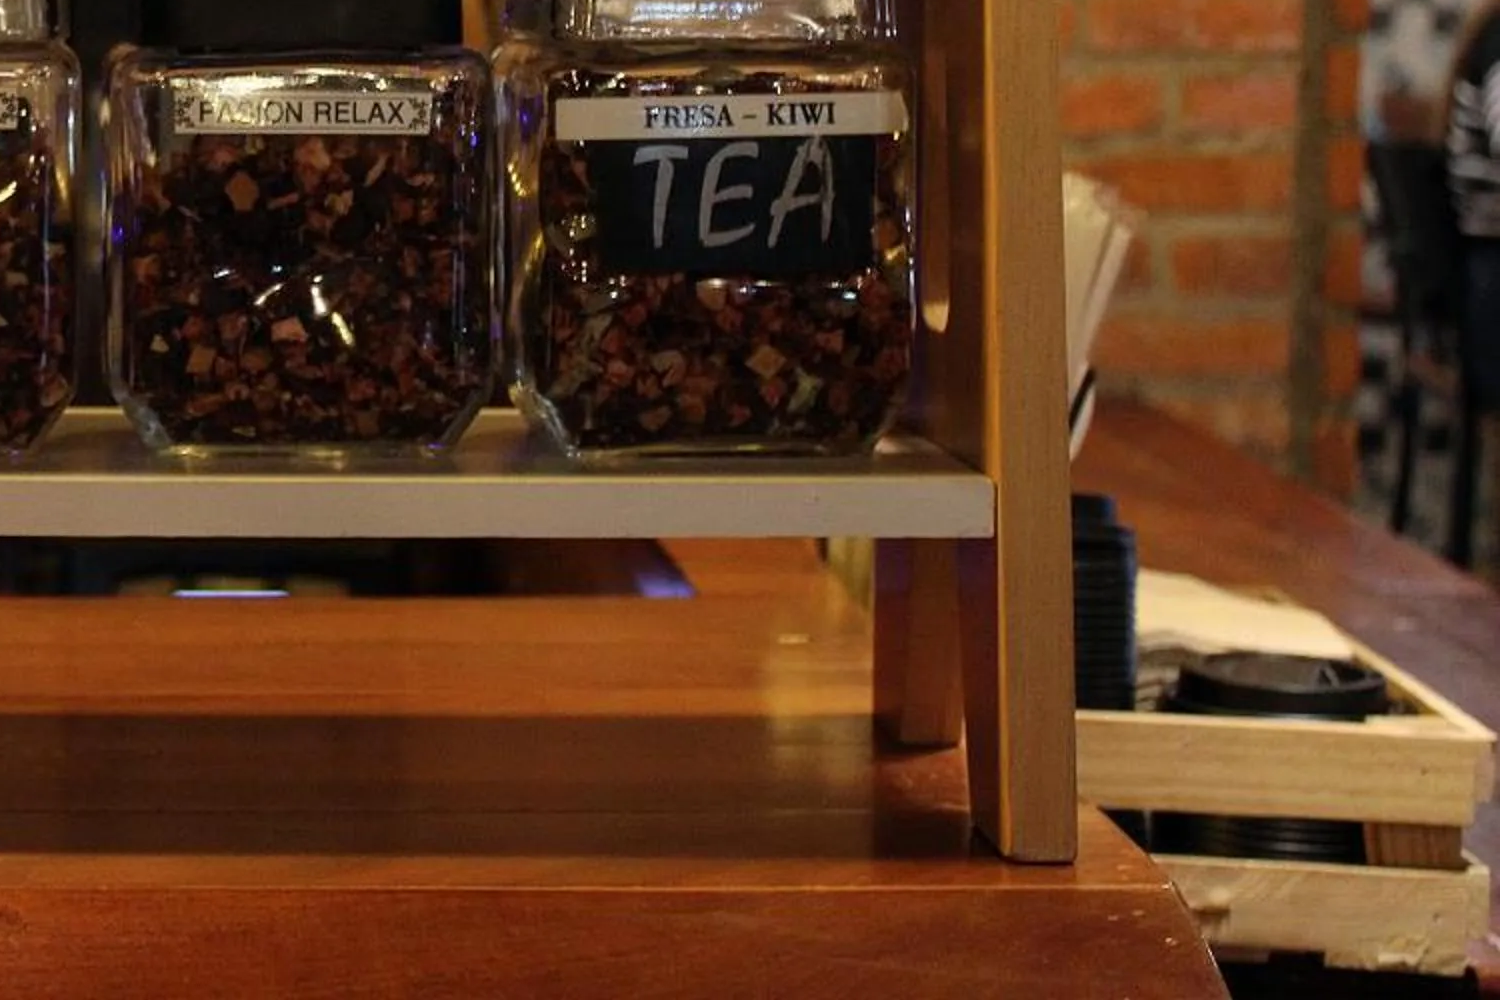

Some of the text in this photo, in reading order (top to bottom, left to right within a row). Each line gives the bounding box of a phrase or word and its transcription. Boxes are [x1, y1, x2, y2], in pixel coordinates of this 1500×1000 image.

[313, 101, 406, 125] RELAX
[644, 104, 735, 130] FRESA
[766, 101, 836, 127] KIWI
[633, 134, 836, 250] TEA
